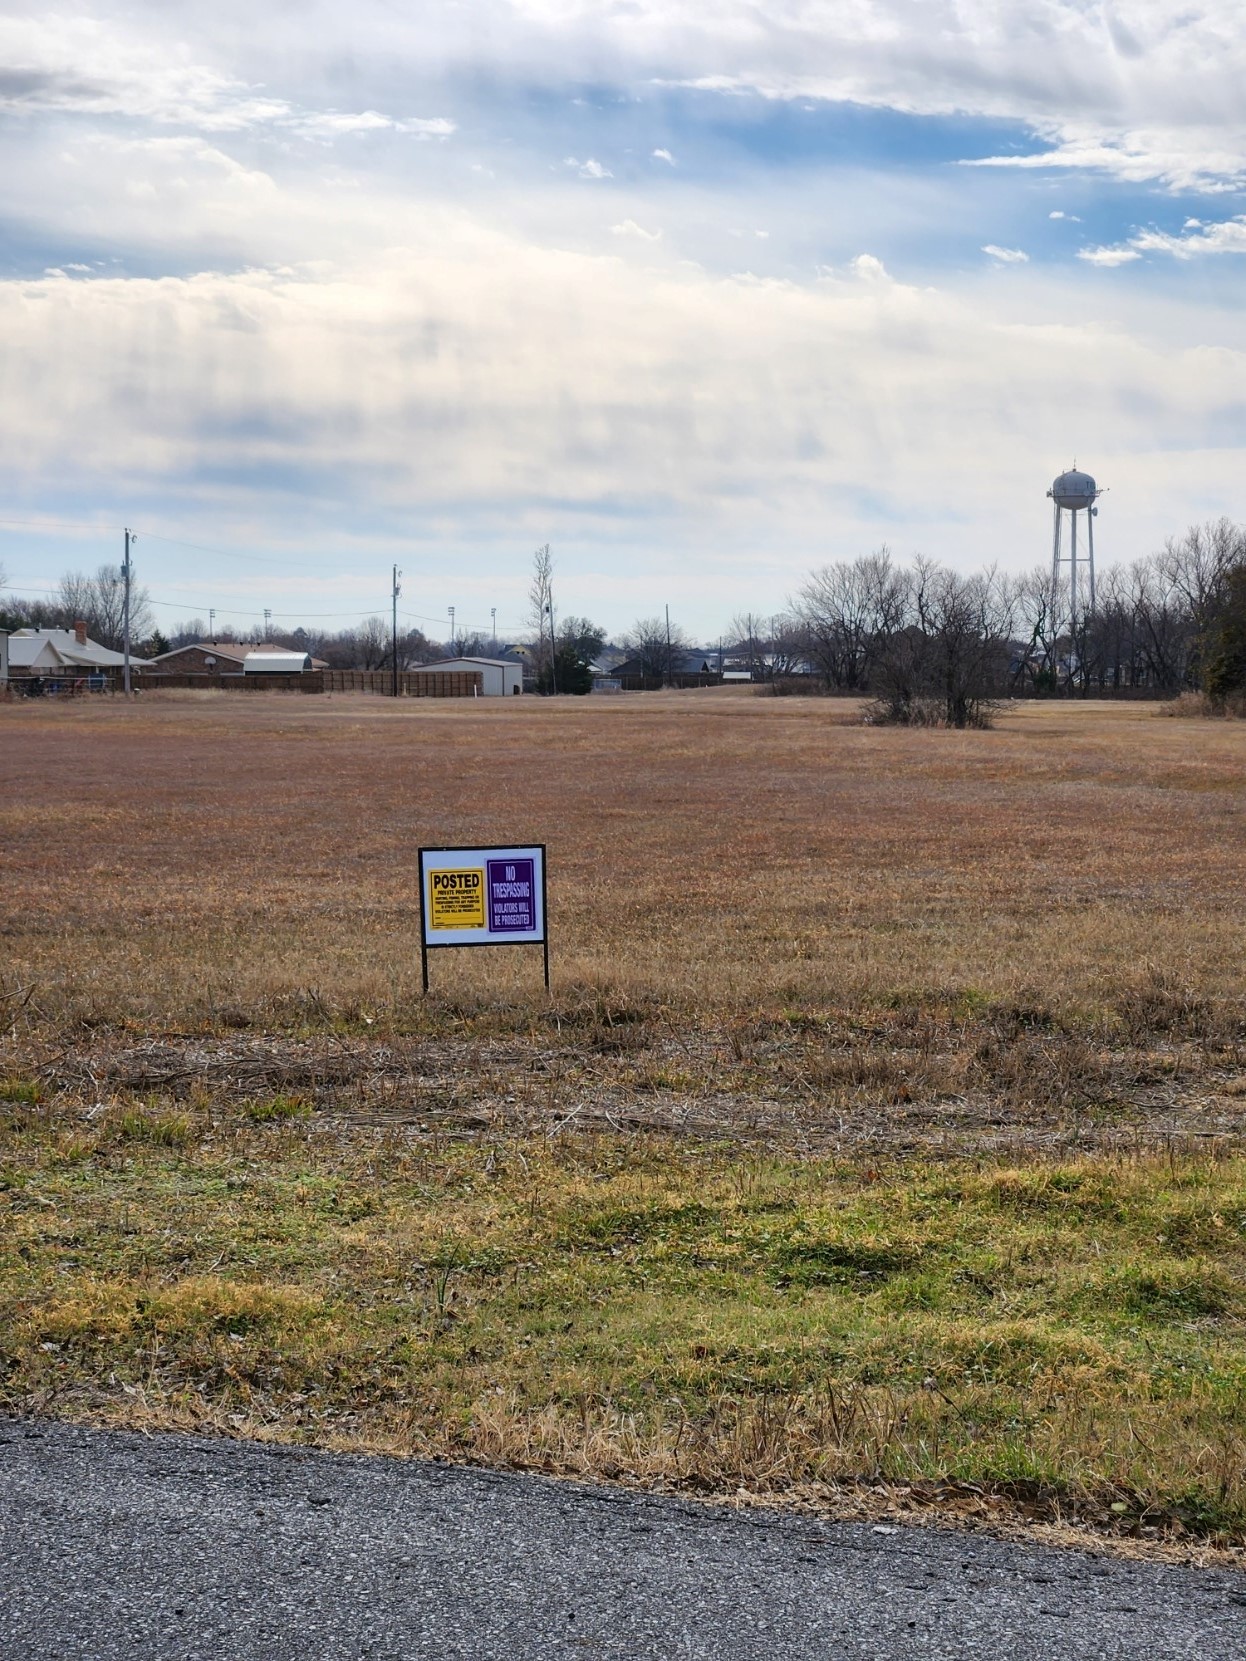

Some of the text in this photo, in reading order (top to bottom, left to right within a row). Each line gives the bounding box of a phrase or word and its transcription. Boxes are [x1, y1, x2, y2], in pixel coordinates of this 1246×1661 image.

[506, 866, 516, 881] NO
[434, 874, 480, 889] POSTED
[492, 882, 530, 898] TRESPASSING
[494, 902, 529, 914] VIOLATORS WILL
[495, 914, 529, 926] BE PROSECUTED
